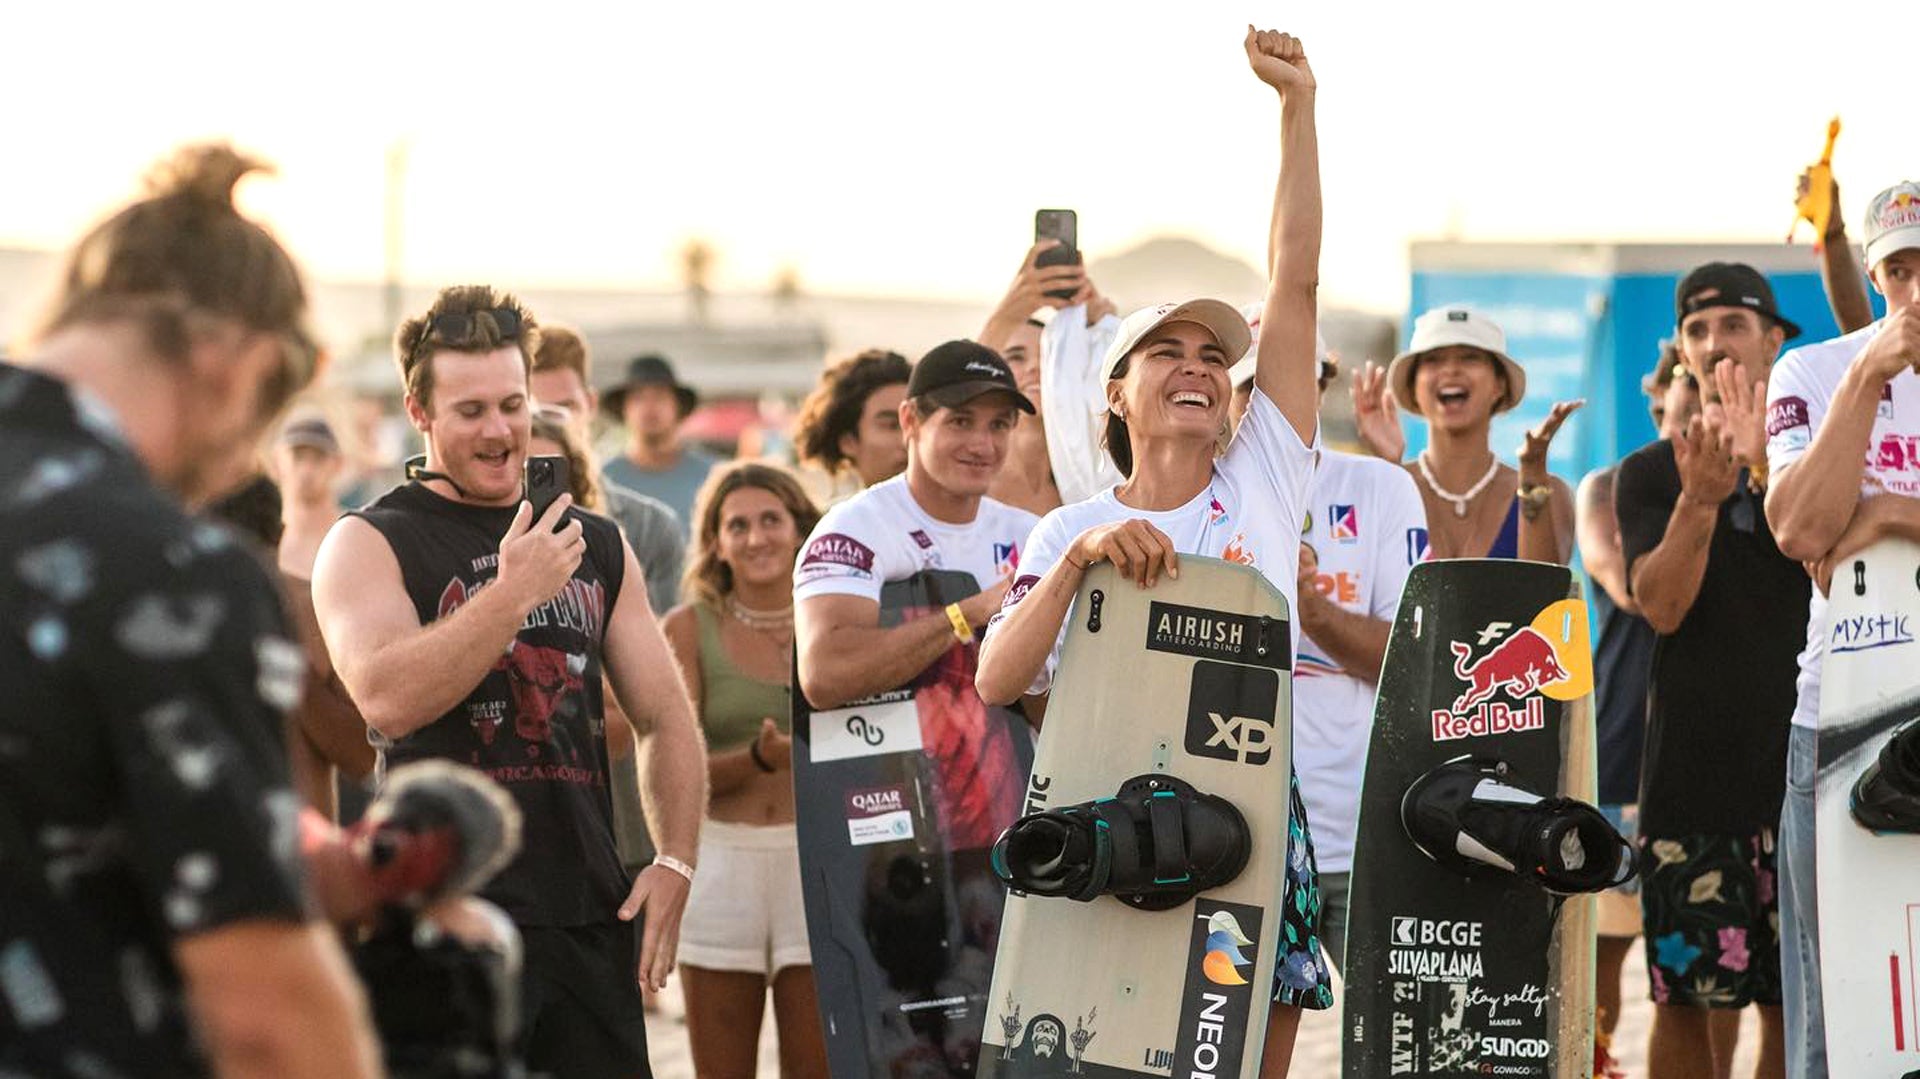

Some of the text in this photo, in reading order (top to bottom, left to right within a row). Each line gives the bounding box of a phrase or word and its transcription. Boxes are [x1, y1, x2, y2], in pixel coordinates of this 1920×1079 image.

[1157, 612, 1244, 646] AIRUSH
[1155, 633, 1242, 654] KITEBOARDING
[1432, 696, 1545, 742] Red Bull
[852, 789, 901, 810] QATAR
[1420, 919, 1483, 947] BCGE
[1387, 948, 1484, 980] SILVAPLANA
[1464, 985, 1500, 1019] stay
[1489, 1018, 1523, 1027] MANERA
[1480, 1036, 1550, 1058] SUNGOD
